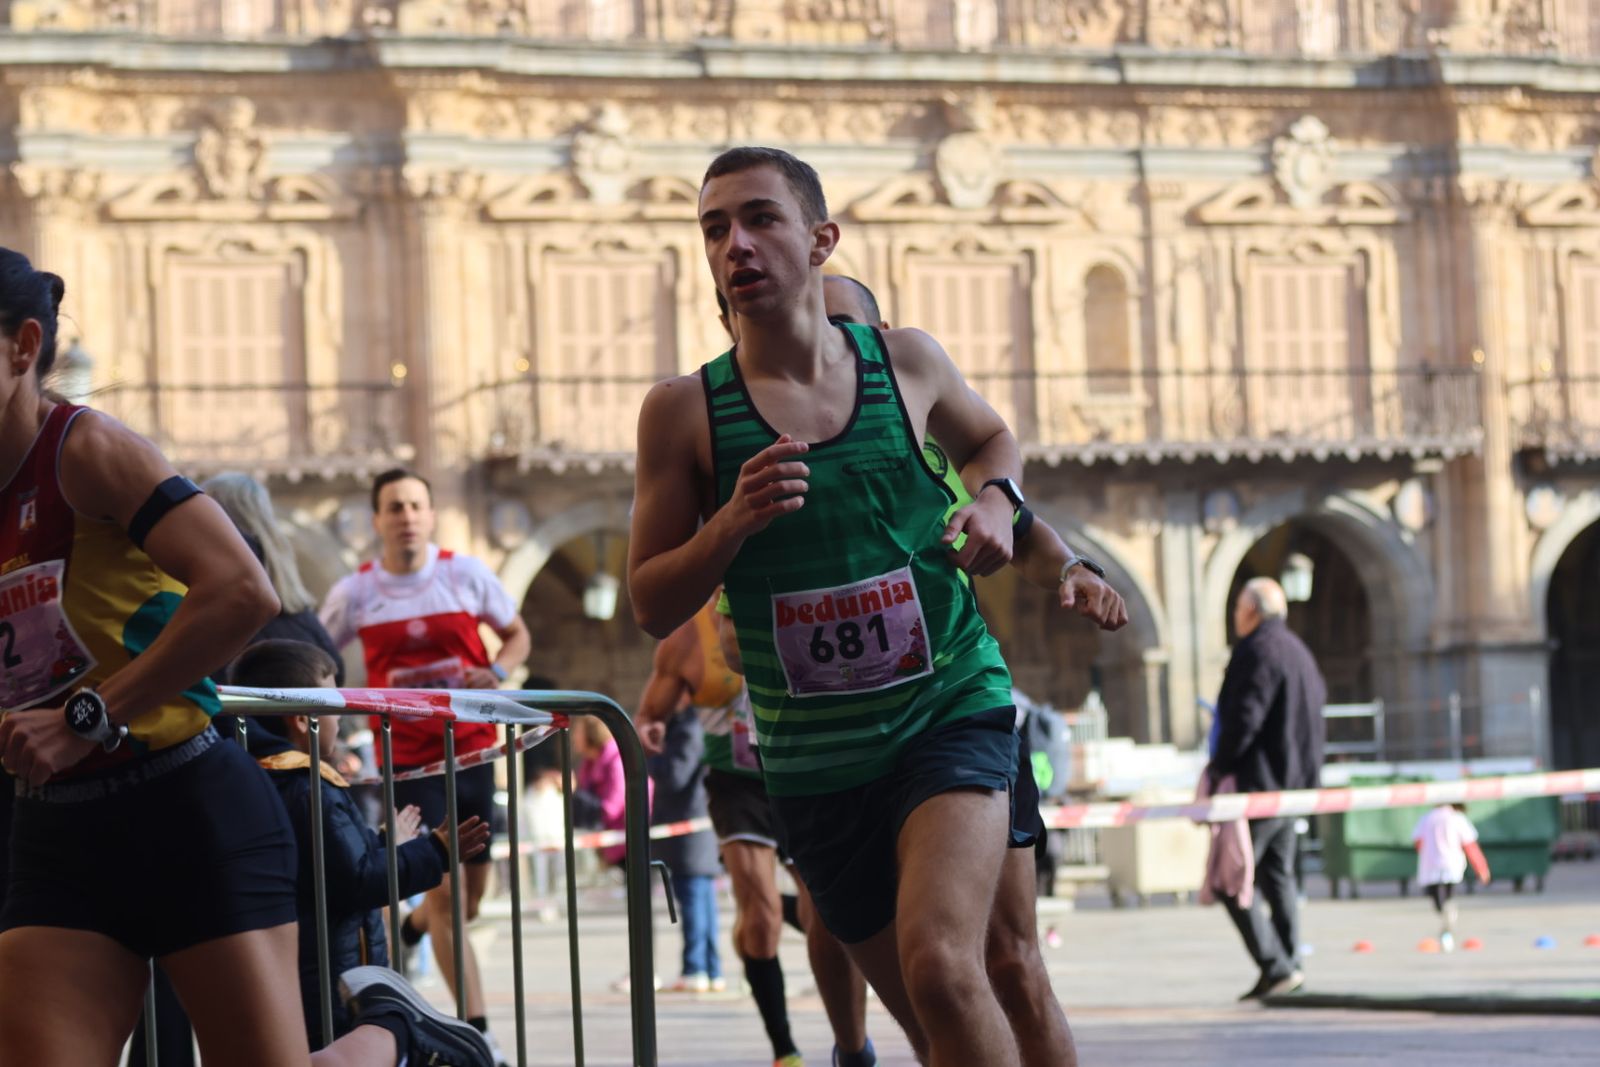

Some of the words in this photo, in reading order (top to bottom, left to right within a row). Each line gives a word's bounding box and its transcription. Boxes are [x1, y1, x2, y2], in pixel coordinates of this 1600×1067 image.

[776, 580, 914, 628] bedunia
[0, 621, 22, 669] 2
[810, 613, 890, 663] 681
